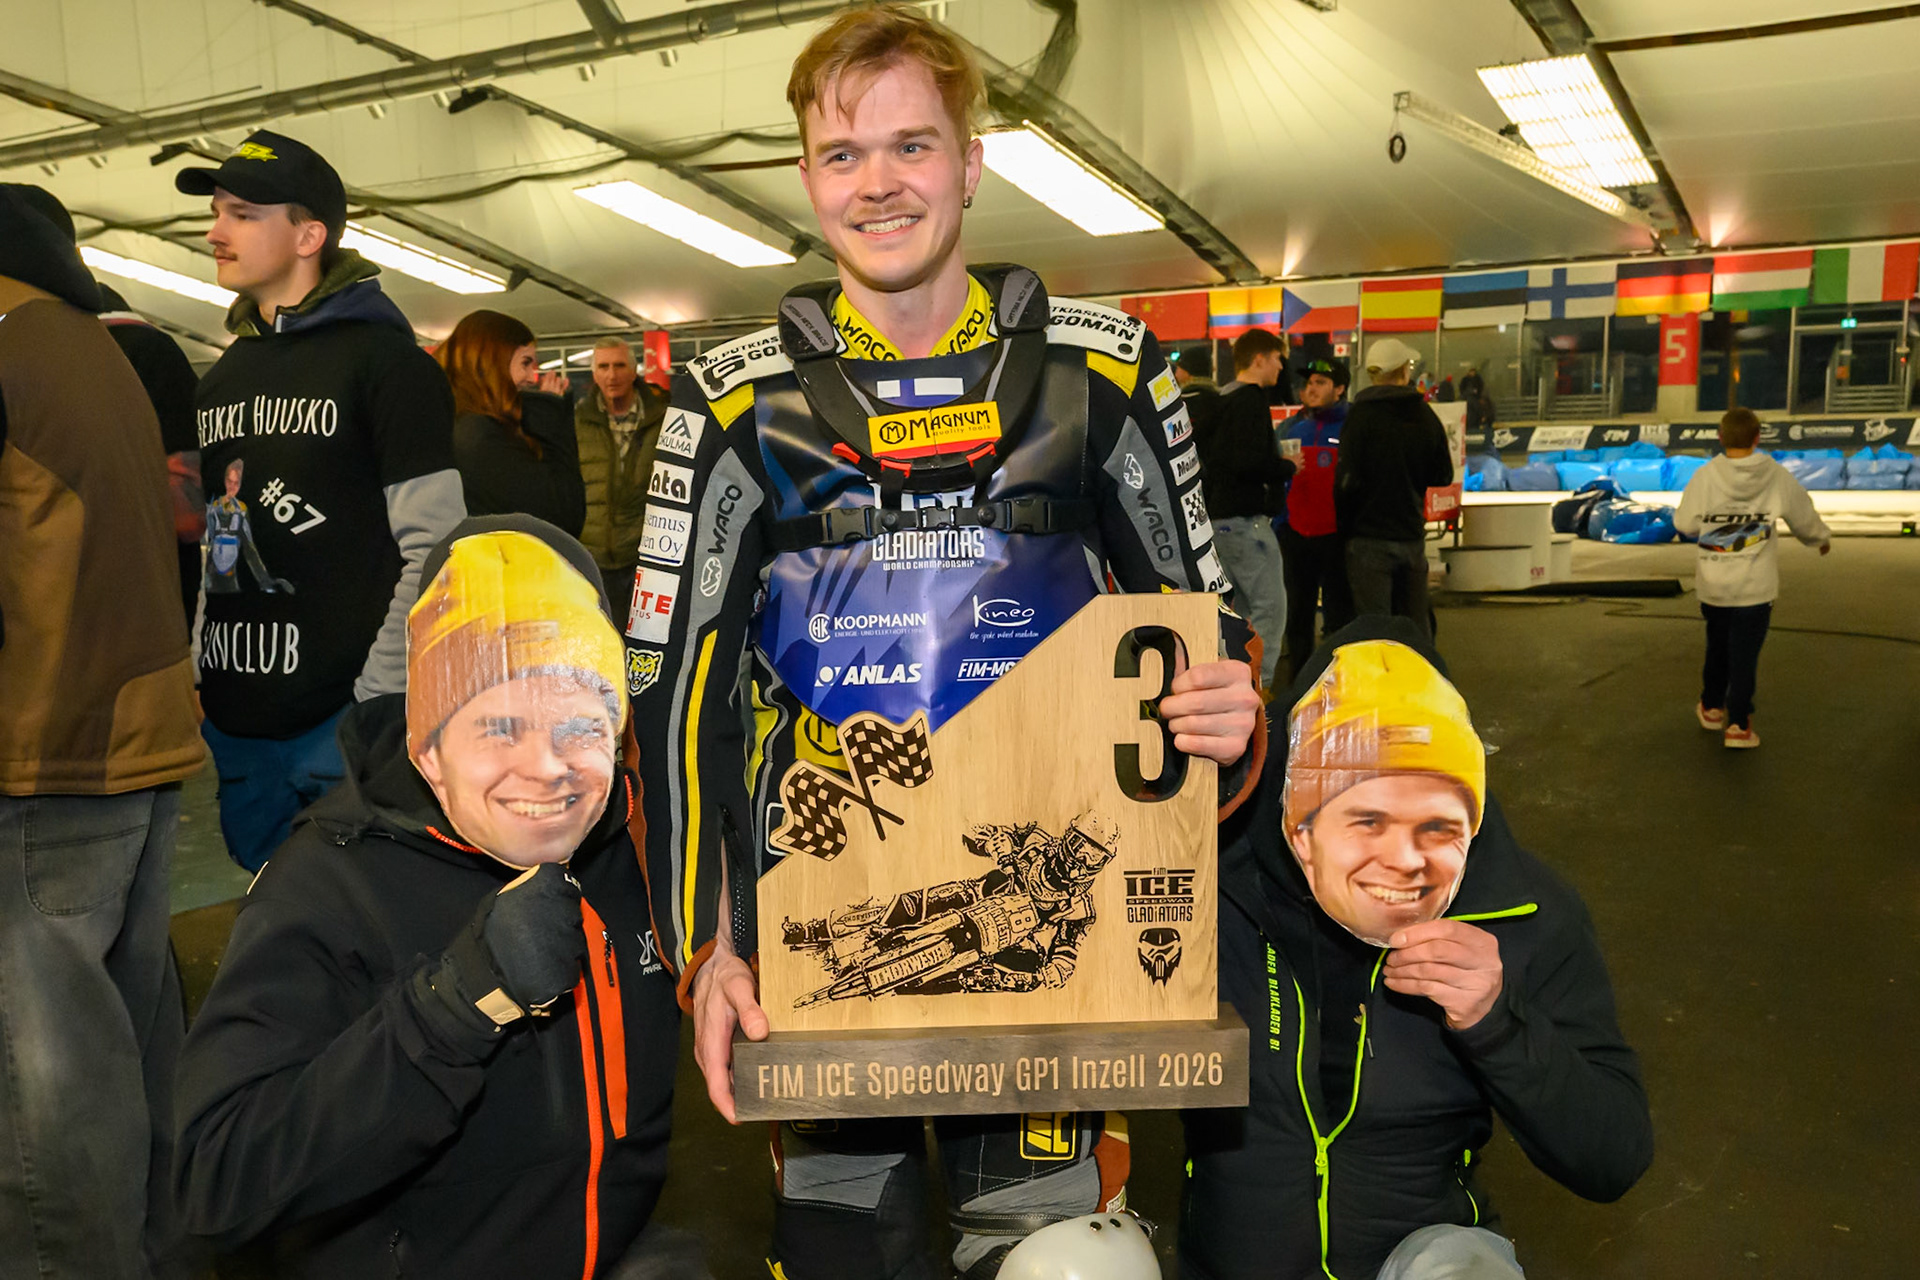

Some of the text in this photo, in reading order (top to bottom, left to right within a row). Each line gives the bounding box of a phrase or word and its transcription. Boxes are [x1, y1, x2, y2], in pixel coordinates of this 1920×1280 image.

[1049, 315, 1136, 341] GOMAN
[1666, 329, 1686, 363] 5
[253, 395, 338, 437] HUUSKO
[909, 409, 991, 441] MAGNUM
[259, 477, 327, 535] #67
[708, 484, 742, 553] WACO
[1137, 487, 1174, 562] WACO
[659, 535, 683, 558] Oy
[883, 561, 911, 571] WORLD
[834, 613, 928, 631] KOOPMANN
[842, 663, 923, 686] ANLAS
[1114, 625, 1190, 803] 3
[1124, 876, 1195, 896] ICE
[758, 1051, 1223, 1100] FIM ICE Speedway GP1 Inzell 2026
